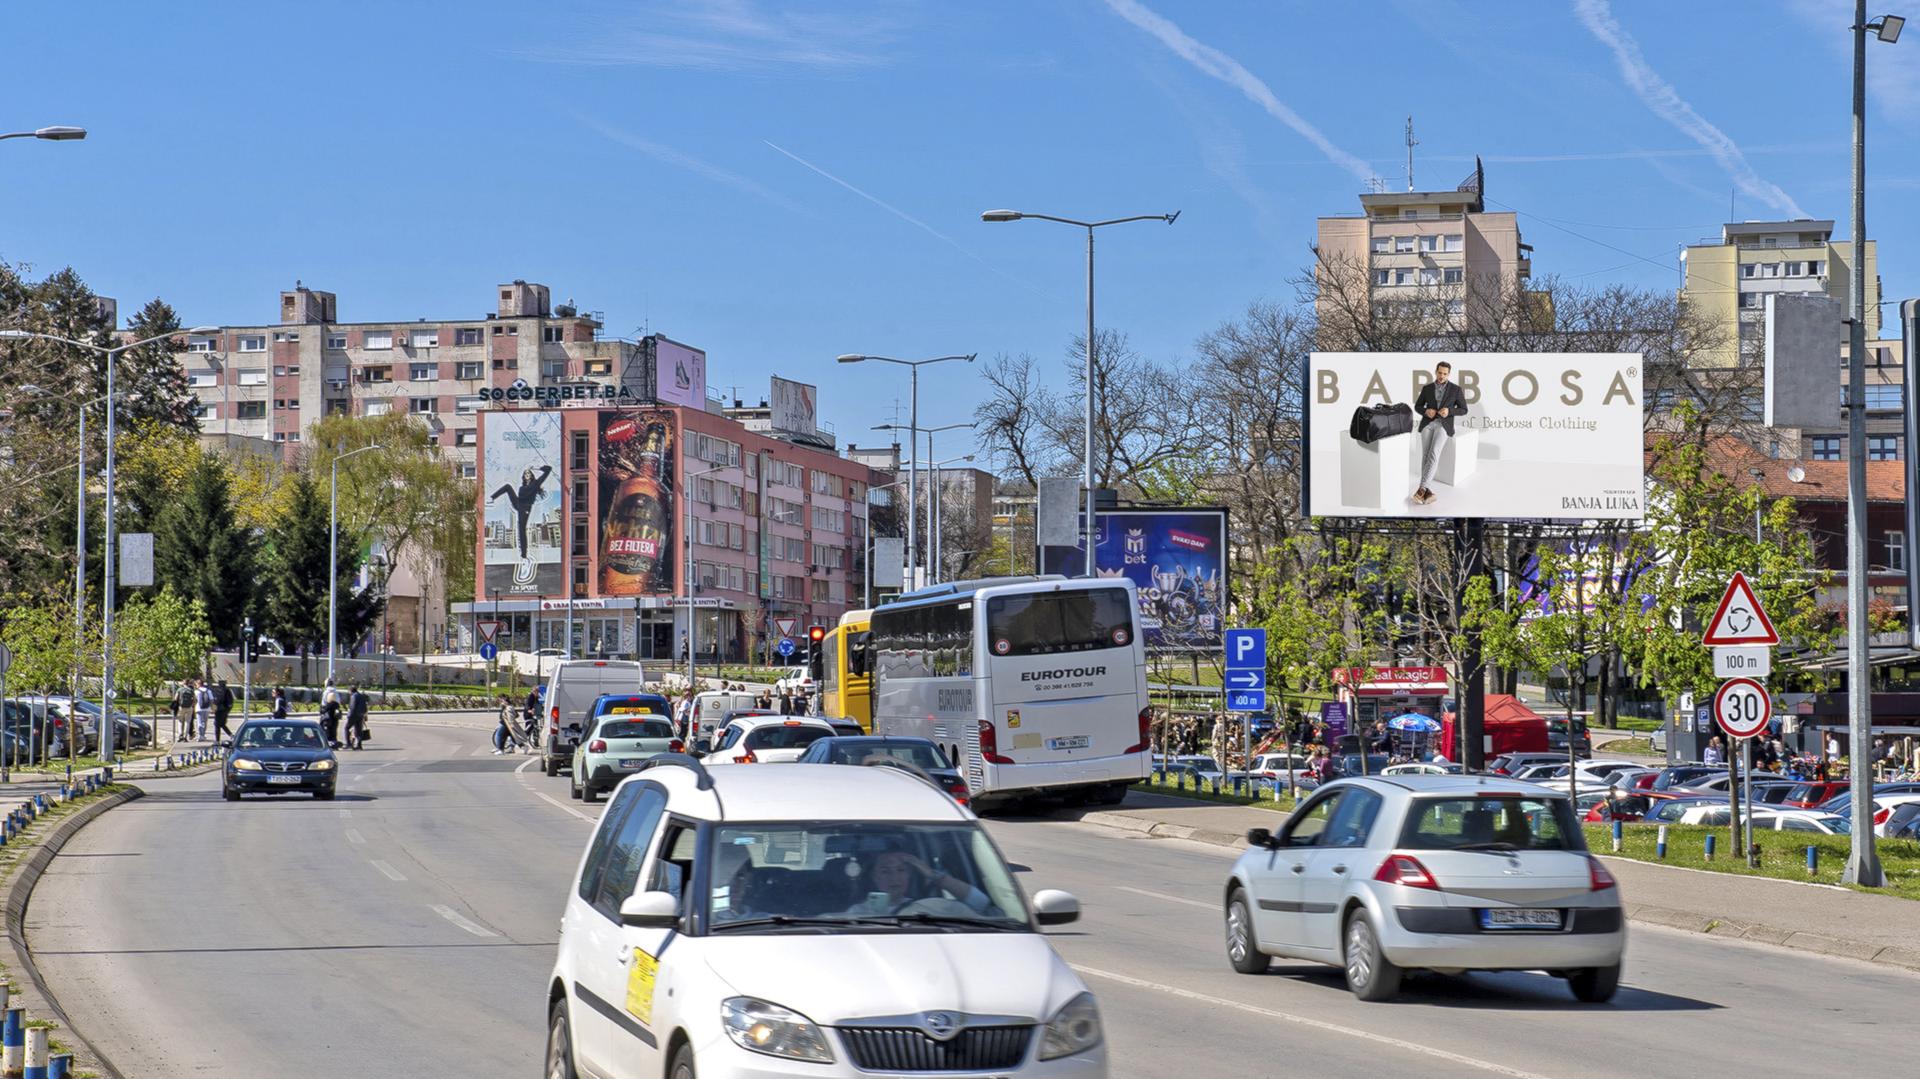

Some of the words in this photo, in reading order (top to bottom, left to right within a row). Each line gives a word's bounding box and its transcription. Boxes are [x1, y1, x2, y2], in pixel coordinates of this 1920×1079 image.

[1483, 417, 1532, 428] Barbosa
[1539, 417, 1597, 431] Clothing
[1562, 497, 1601, 510] BANJA
[1606, 497, 1638, 509] LUKA
[610, 540, 624, 551] BEZ
[625, 540, 655, 554] FILTERA
[1237, 636, 1254, 661] P
[1726, 655, 1744, 668] 100
[1747, 658, 1757, 668] m
[1021, 666, 1106, 681] EUROTOUR
[1728, 693, 1758, 722] 30
